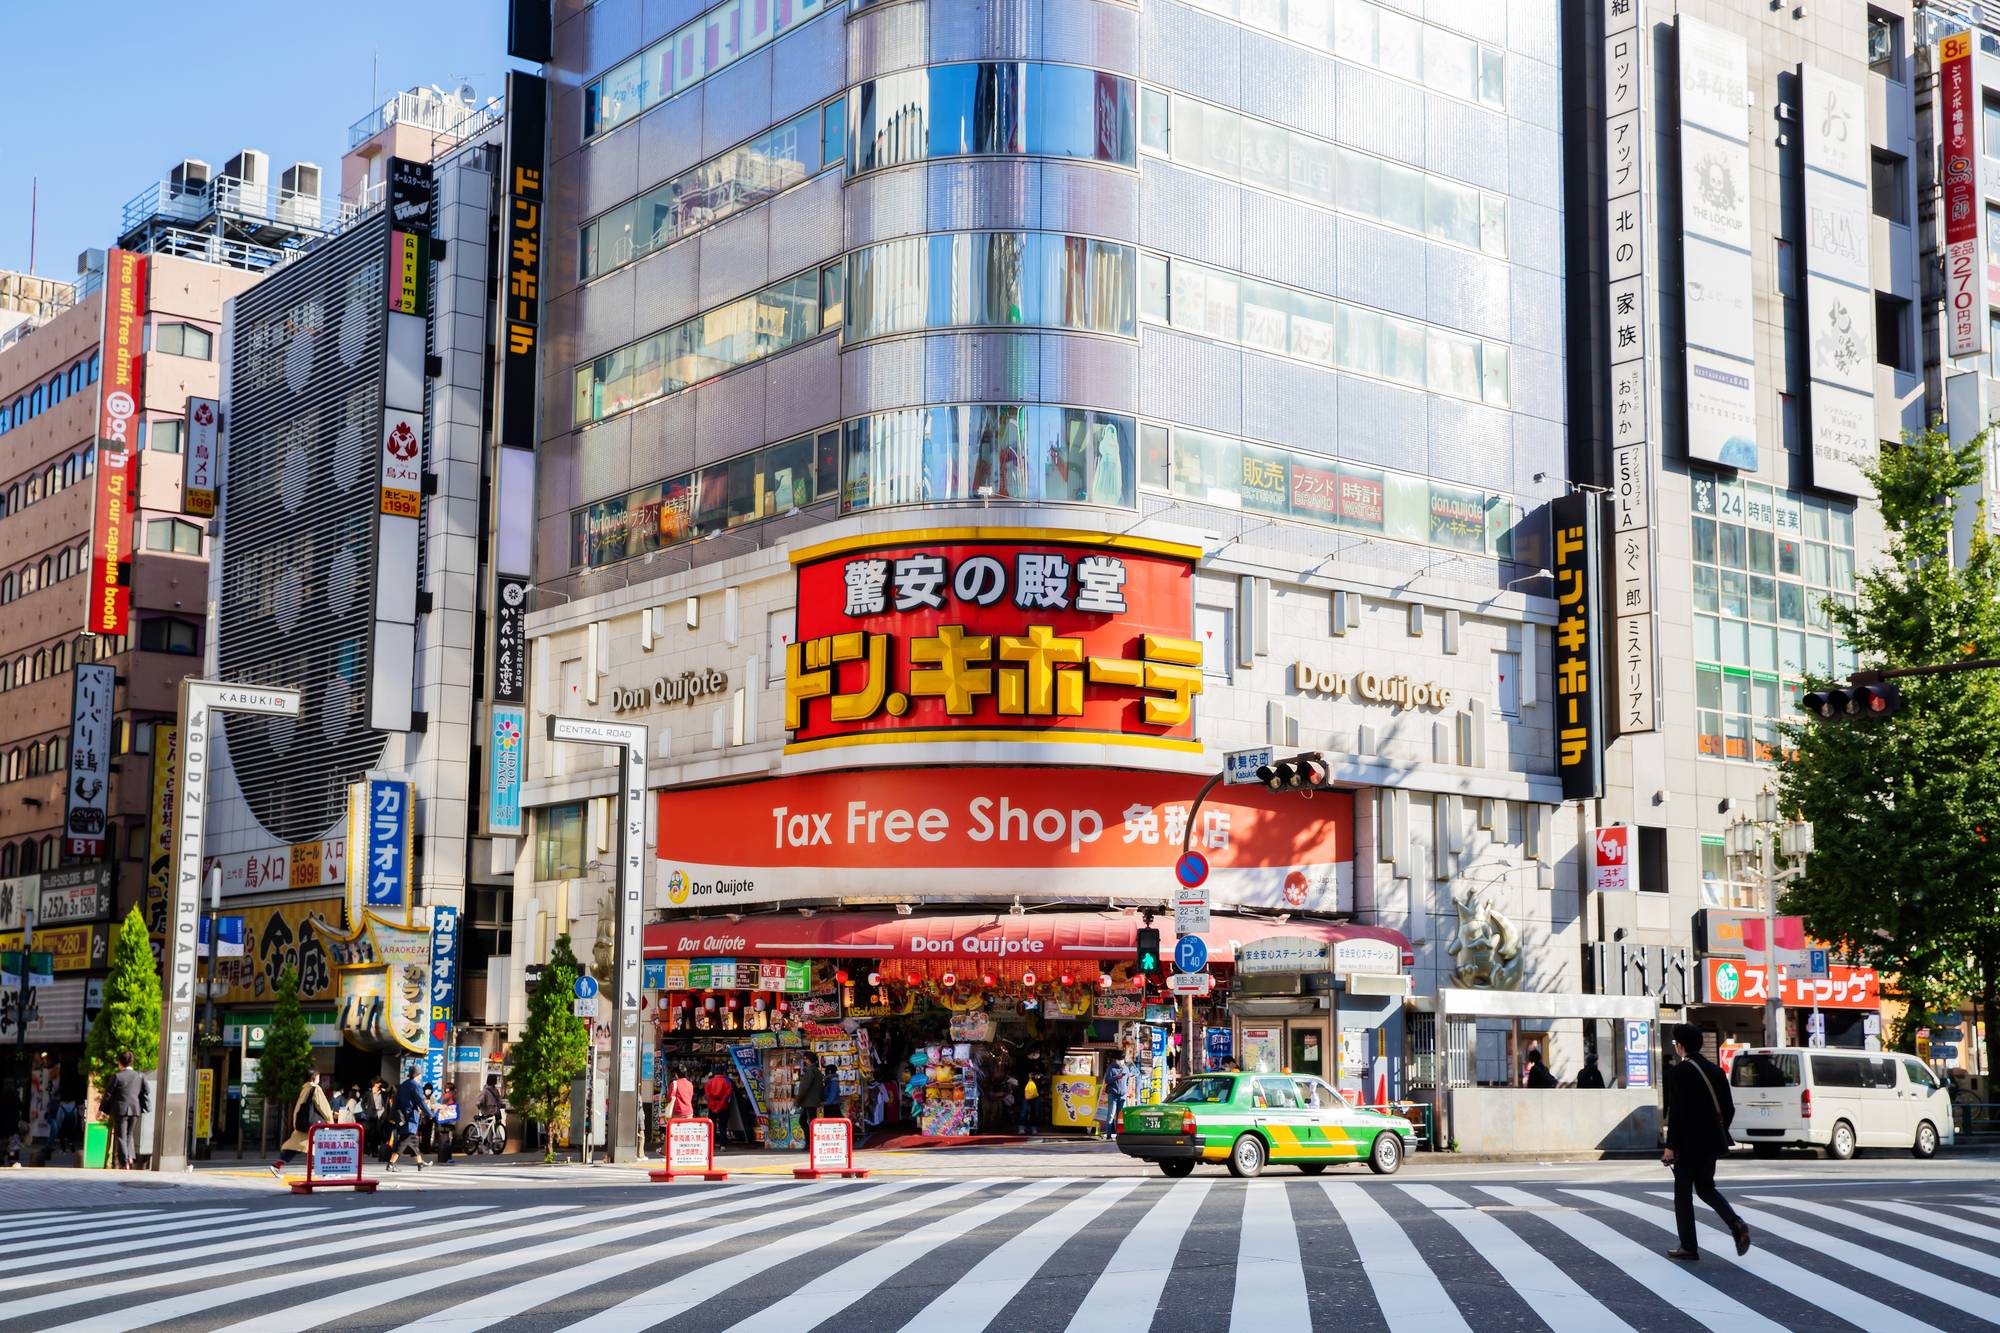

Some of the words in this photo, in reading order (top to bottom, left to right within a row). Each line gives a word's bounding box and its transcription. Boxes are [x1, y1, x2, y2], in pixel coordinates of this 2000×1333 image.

[1944, 39, 1967, 58] 8F
[1614, 42, 1632, 185] ロックアップ
[1693, 206, 1709, 222] THE
[1709, 210, 1743, 231] LOCKUP
[510, 166, 540, 355] ドン・キホーテ
[1950, 242, 1974, 258] 全品
[121, 254, 136, 284] free
[1616, 210, 1636, 348] 北の家族
[119, 287, 136, 314] wifi
[118, 316, 133, 345] free
[116, 346, 132, 385] drink
[1618, 380, 1632, 434] おかか
[195, 445, 209, 486] 鳥メロ
[385, 467, 418, 480] 鳥メロ
[1243, 456, 1285, 492] 販売
[107, 475, 124, 497] try
[385, 490, 417, 502] 生ビール
[1293, 473, 1334, 495] ブランド
[1342, 482, 1382, 504] 時計
[1620, 452, 1633, 528] ESOLA
[107, 498, 122, 524] our
[104, 526, 120, 584] capsule
[843, 553, 1128, 616] 驚安の殿堂
[1624, 538, 1641, 606] ふぐ一郎
[102, 587, 120, 629] booth
[499, 607, 515, 696] かんかん商店
[1557, 526, 1587, 766] ドン・キホーテ
[786, 624, 1203, 729] ドン・キホーテ
[1296, 661, 1350, 696] Don
[1358, 671, 1454, 711] Quijote
[1628, 621, 1643, 727] ミステリアス
[611, 687, 647, 712] Don
[652, 668, 724, 705] Quijote
[559, 724, 604, 736] CENTRAL
[606, 728, 632, 738] ROAD
[182, 733, 203, 883] GODZILLA
[773, 806, 832, 848] Tax
[847, 800, 949, 843] Free
[967, 796, 1103, 853] Shop
[1122, 803, 1231, 851] 免税店
[73, 839, 97, 855] B1
[292, 845, 320, 862] 生ビール
[325, 842, 344, 859] 入口
[373, 786, 400, 899] カラオケ
[245, 855, 285, 888] 鳥メロ
[1598, 878, 1627, 888] ドラッグ
[692, 882, 712, 896] Don
[717, 879, 754, 895] Quijote
[93, 934, 105, 958] 2F
[177, 902, 195, 974] ROAD
[678, 936, 700, 951] Don
[703, 935, 746, 952] Quijote
[911, 936, 954, 952] Don
[963, 936, 1044, 957] Quijote
[434, 910, 455, 1001] カラオケ
[1182, 944, 1194, 967] P
[1190, 957, 1200, 967] 40
[1814, 952, 1822, 965] P
[402, 965, 423, 1039] カラオケ
[432, 1005, 450, 1021] B1
[1629, 1028, 1639, 1050] P
